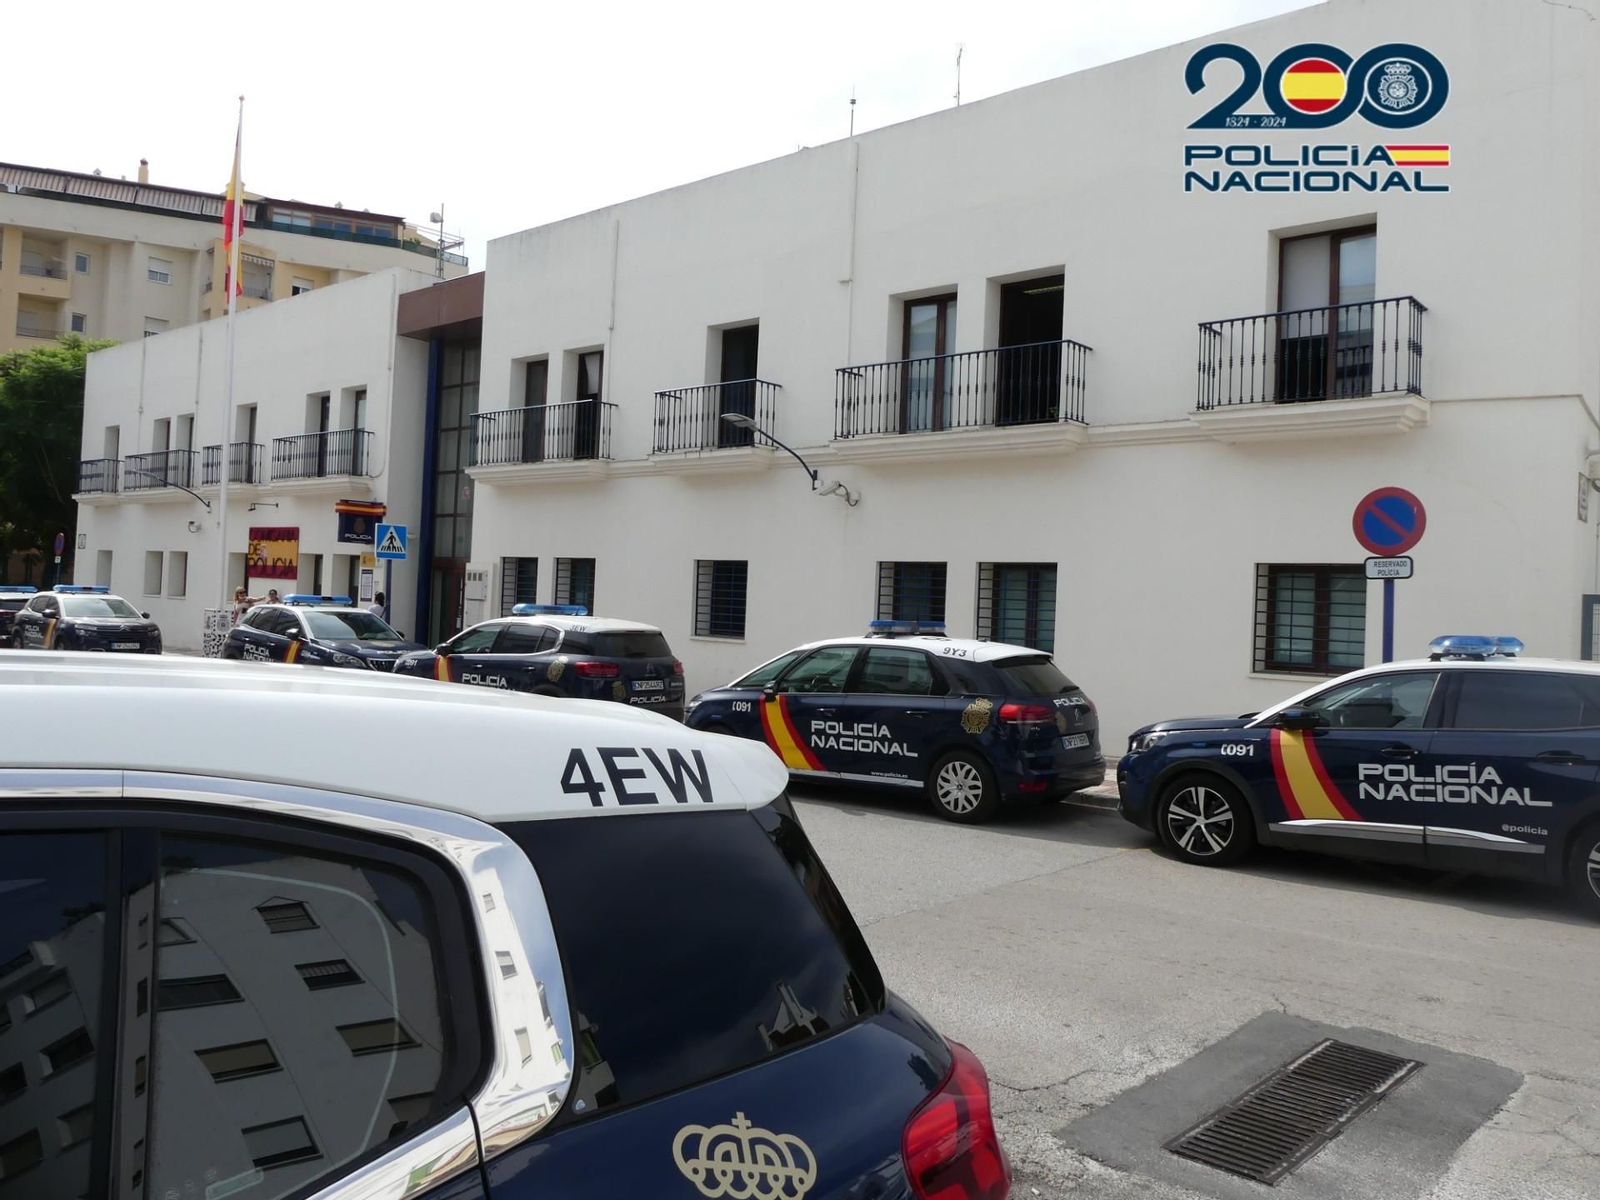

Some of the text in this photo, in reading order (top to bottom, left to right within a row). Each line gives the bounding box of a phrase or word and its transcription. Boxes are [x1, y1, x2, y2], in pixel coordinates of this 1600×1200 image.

[1373, 560, 1408, 568] RESERVADO
[942, 647, 968, 658] 9Y3
[462, 673, 508, 688] POLICÍA
[811, 720, 892, 739] POLICÍA
[811, 734, 919, 758] NACIONAL
[560, 746, 714, 807] 4EW
[1358, 762, 1503, 784] POLICÍA
[1358, 782, 1553, 807] NACIONAL
[1501, 824, 1548, 835] @policia
